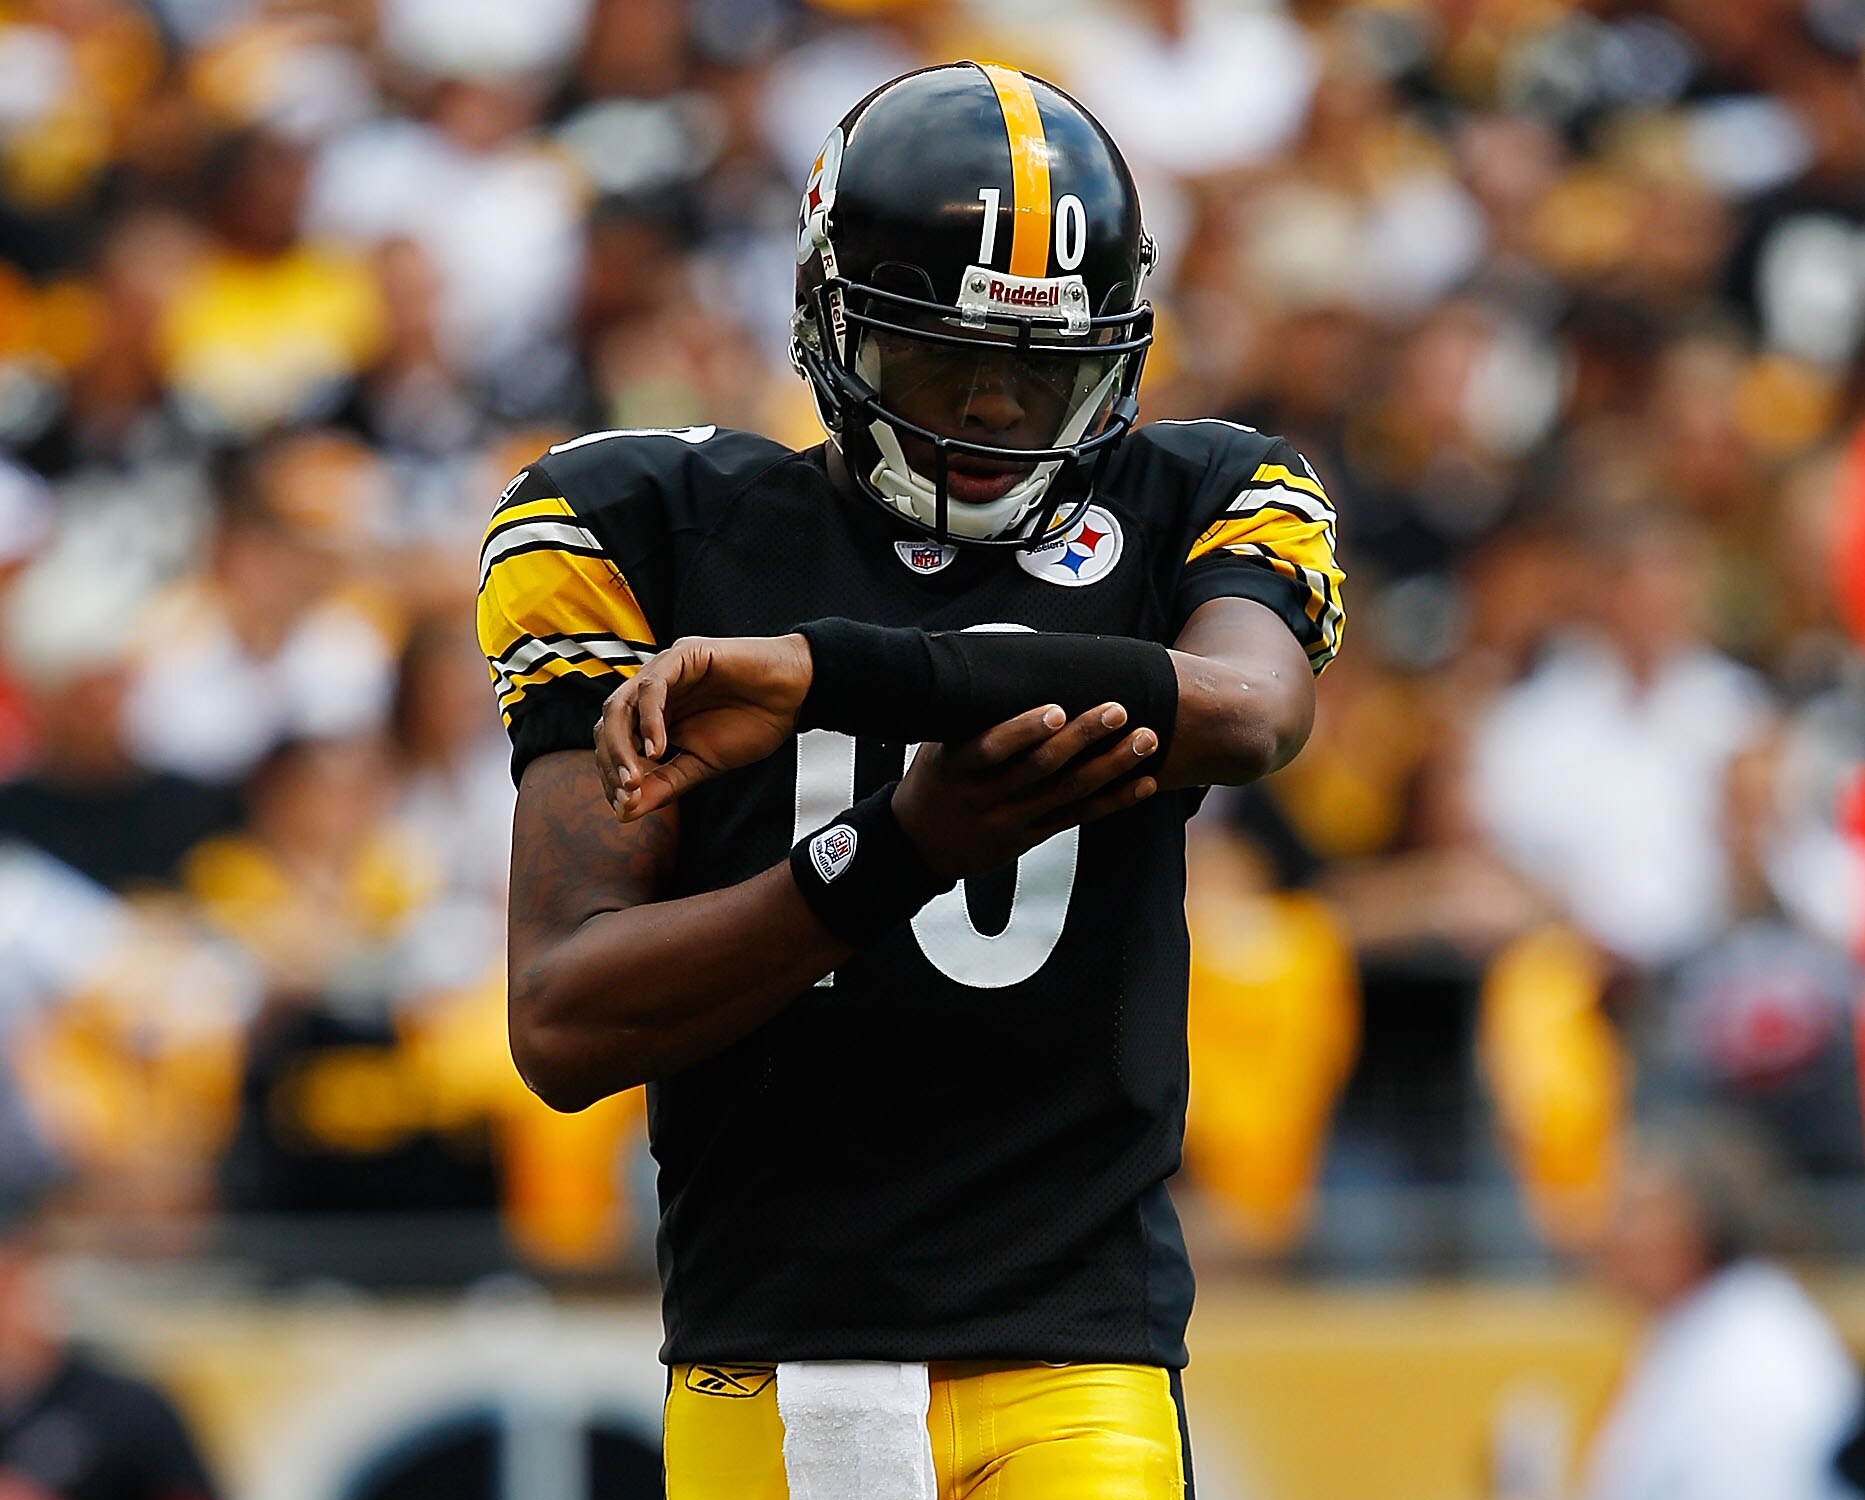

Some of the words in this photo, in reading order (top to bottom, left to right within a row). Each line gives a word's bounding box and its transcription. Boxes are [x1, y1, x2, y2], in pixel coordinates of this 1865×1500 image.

[978, 188, 1087, 271] 10
[989, 279, 1060, 307] Riddell
[914, 555, 940, 567] NFL
[833, 833, 849, 857] NFL
